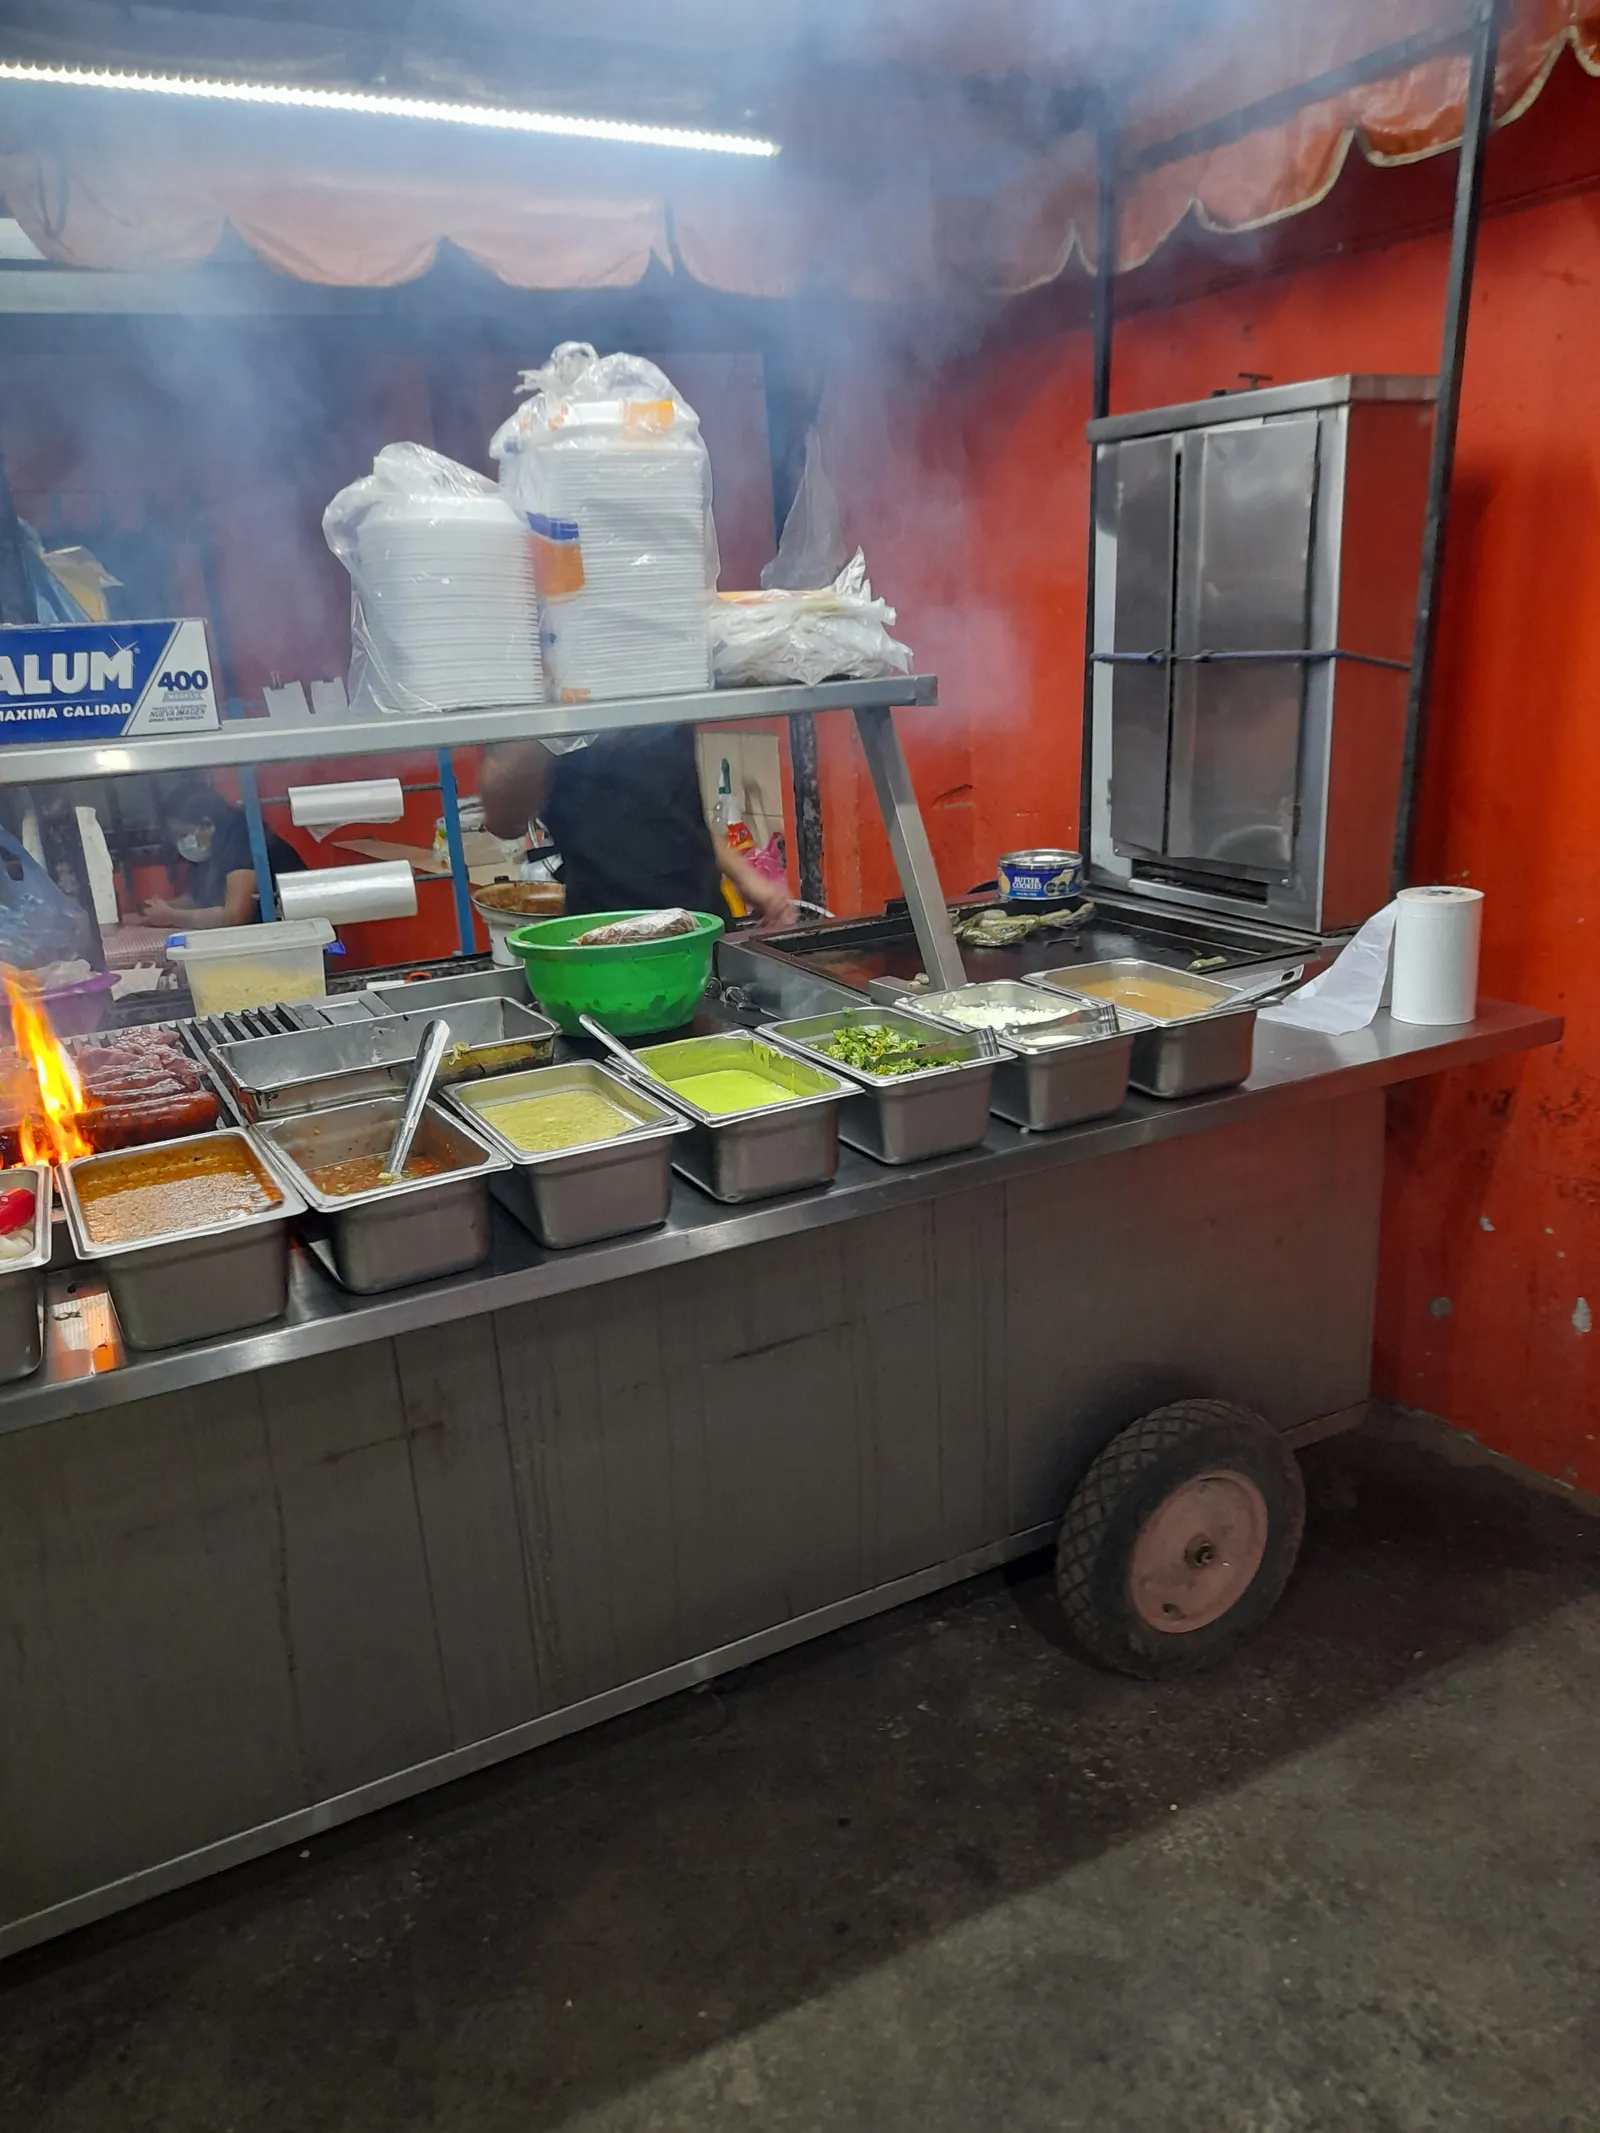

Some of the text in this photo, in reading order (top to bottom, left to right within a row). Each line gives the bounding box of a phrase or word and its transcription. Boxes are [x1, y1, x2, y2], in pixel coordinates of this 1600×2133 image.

[158, 670, 208, 691] 400
[0, 703, 132, 722] AXIMA CALIDAD
[150, 707, 206, 718] NUEVA IMAGEN
[1012, 881, 1042, 889] COOKIES
